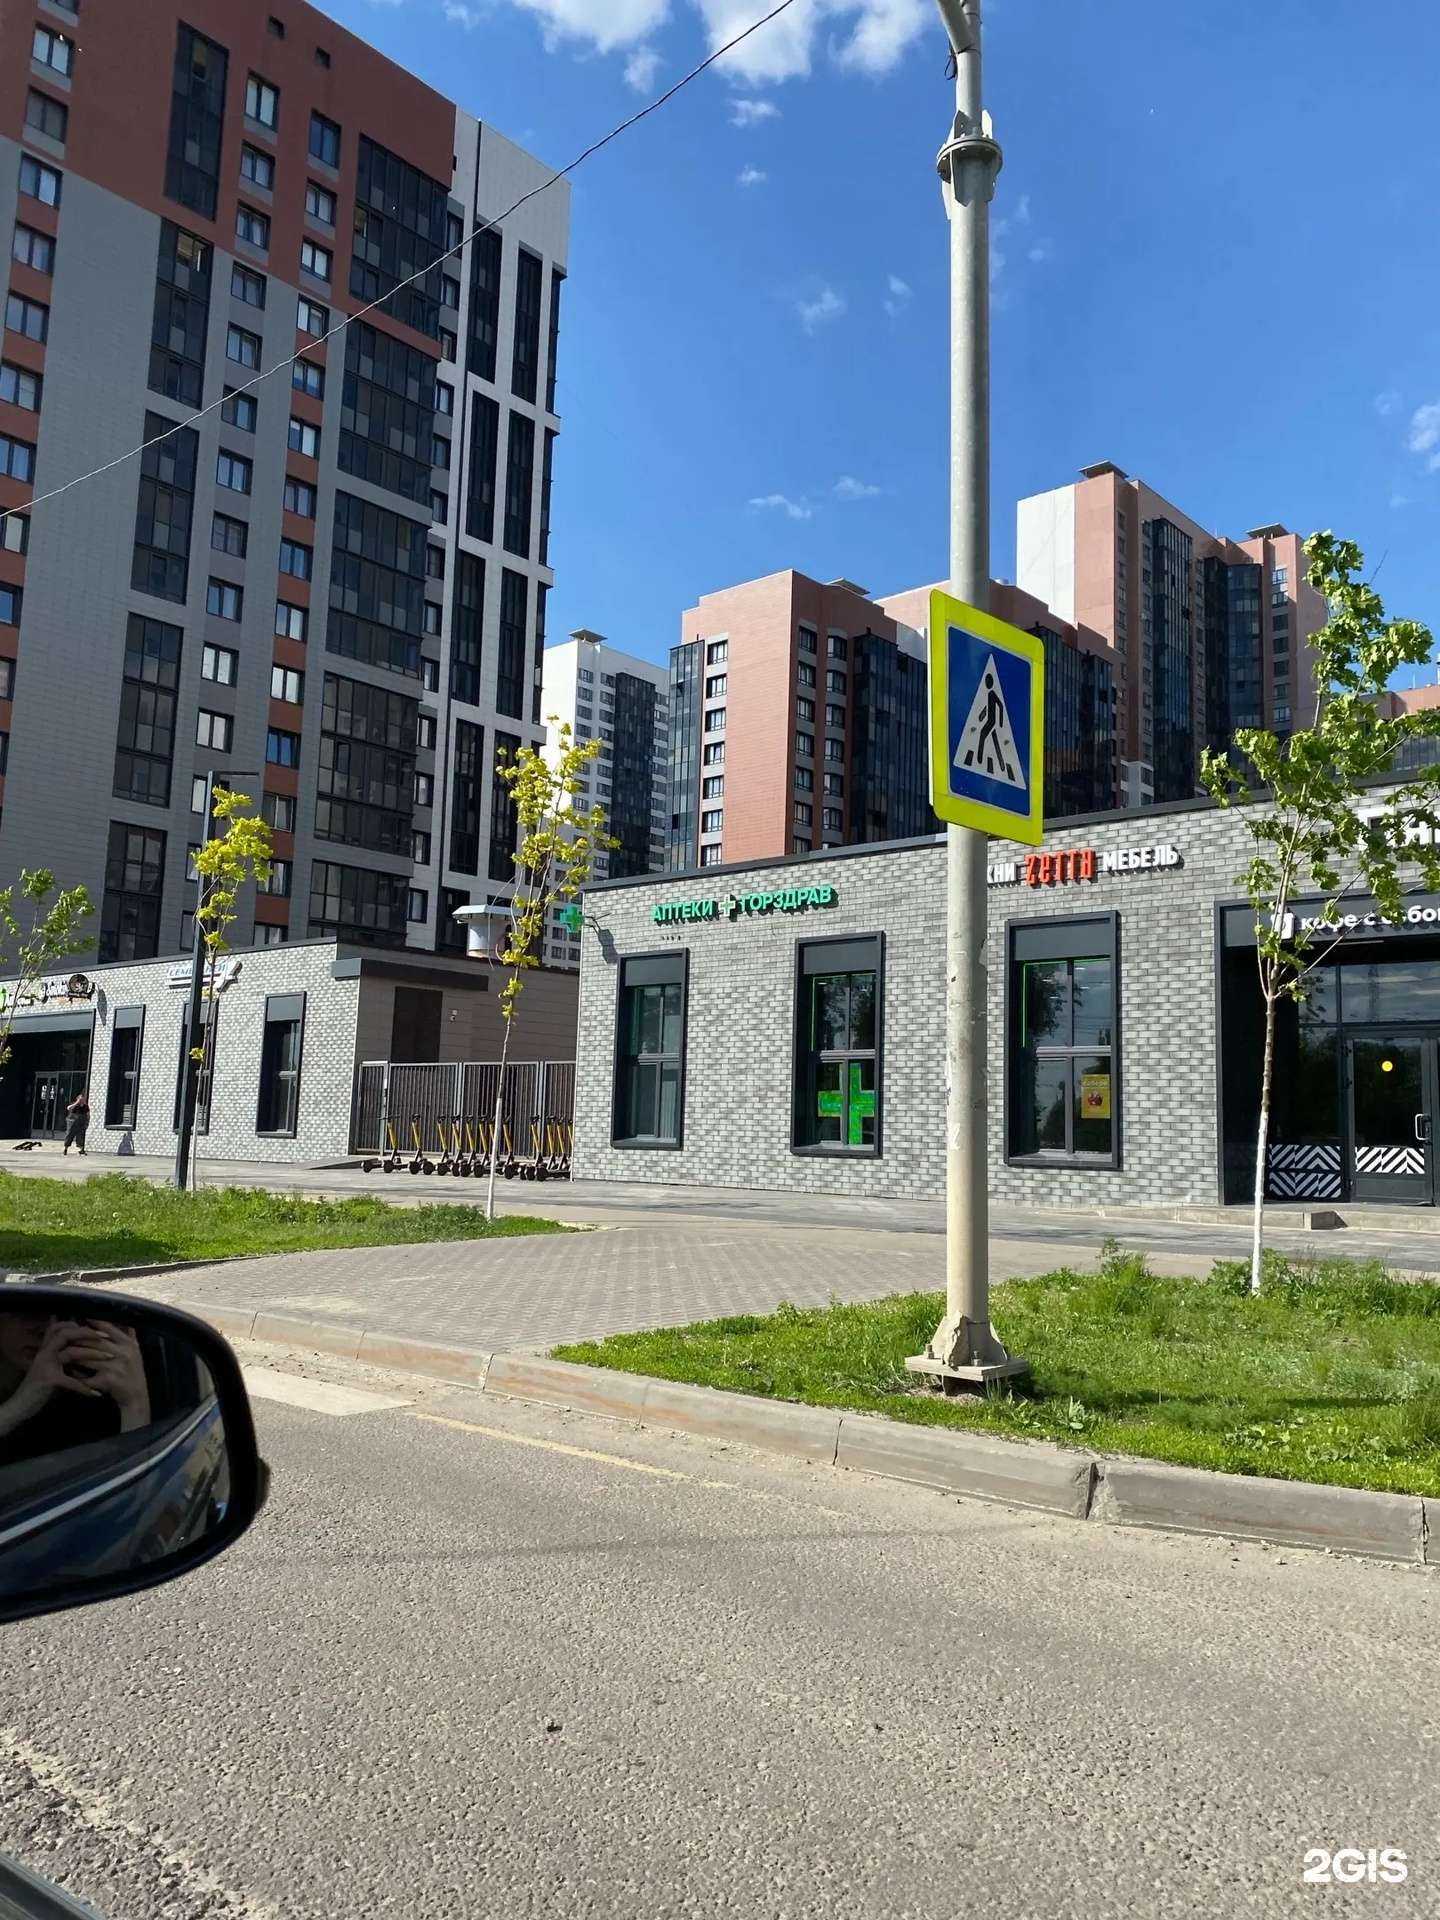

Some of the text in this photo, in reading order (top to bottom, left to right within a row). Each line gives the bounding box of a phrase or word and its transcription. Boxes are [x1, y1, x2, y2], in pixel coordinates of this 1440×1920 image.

[1103, 844, 1179, 872] МЕБЕЛЬ
[651, 884, 832, 922] АПТЕКИ ГОРЗДРАВ
